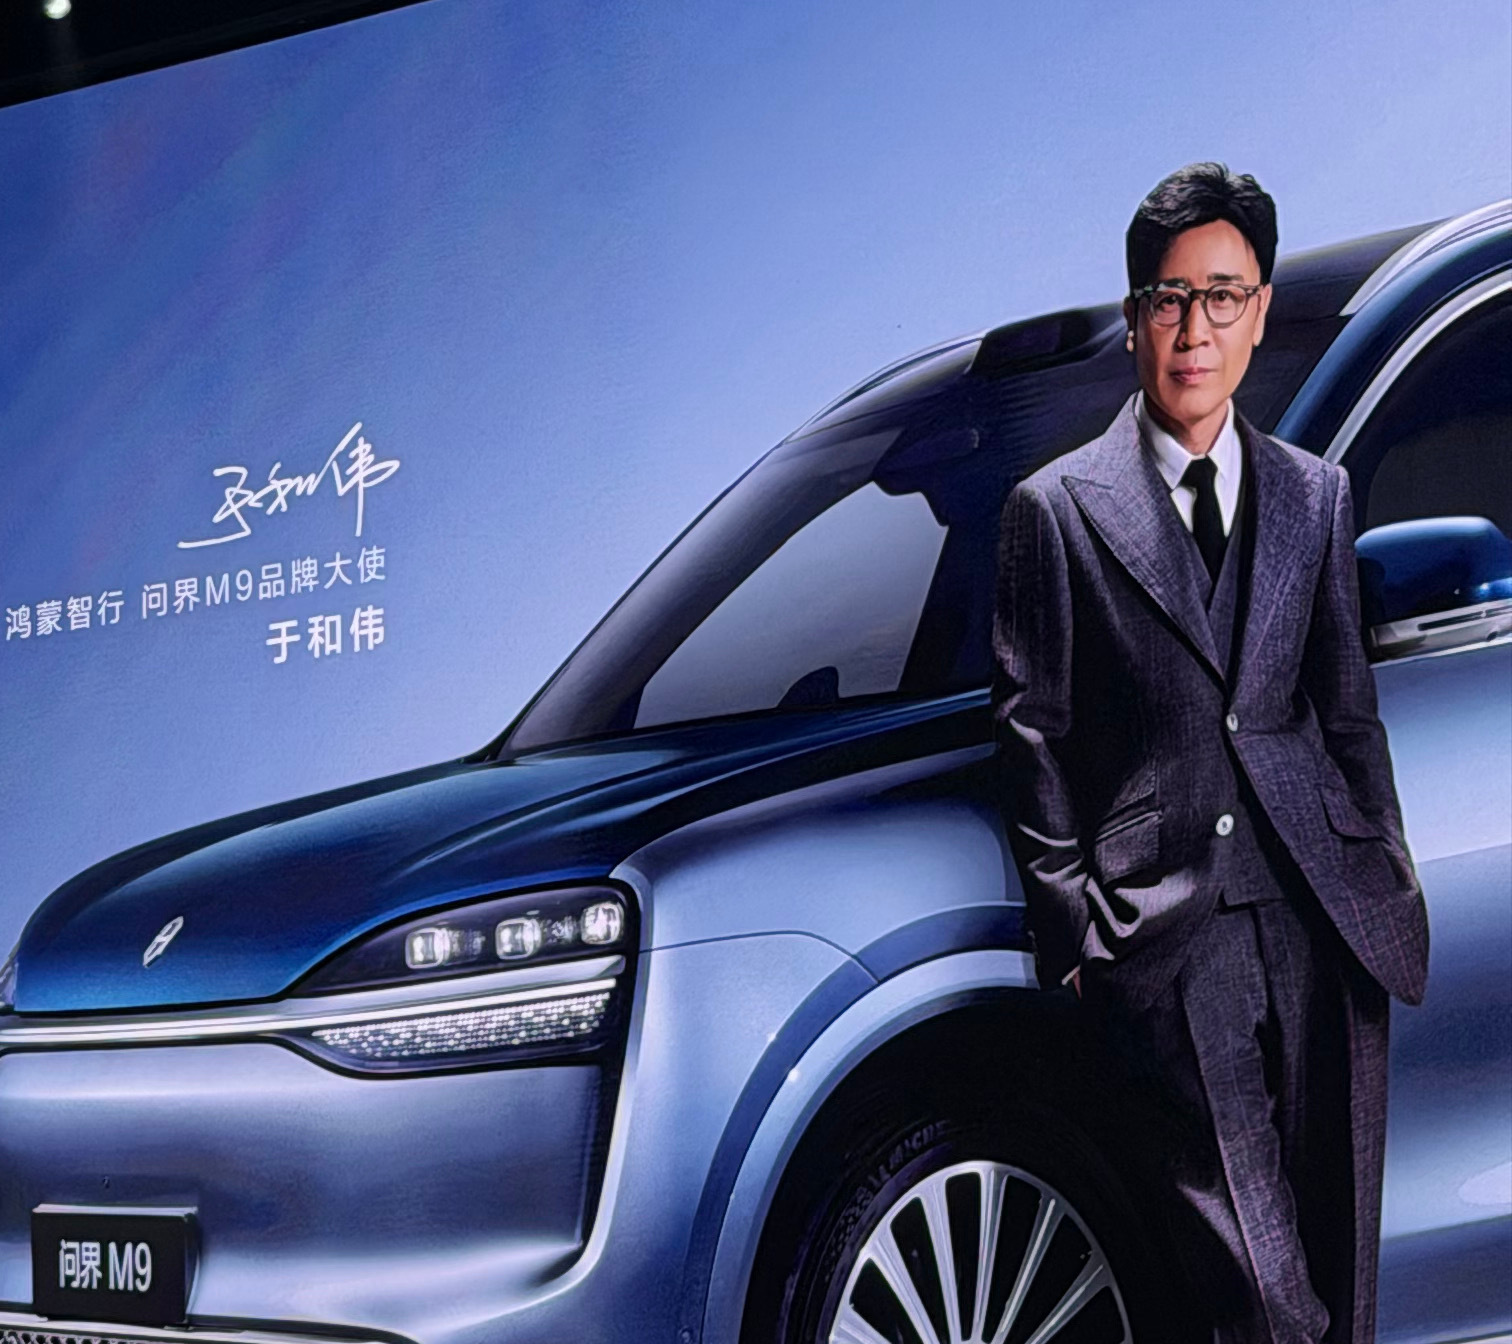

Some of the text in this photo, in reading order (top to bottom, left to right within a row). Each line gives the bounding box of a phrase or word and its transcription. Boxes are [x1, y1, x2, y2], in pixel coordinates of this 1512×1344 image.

[5, 545, 387, 641] 鸿蒙智行 问界M9品牌大使
[266, 605, 385, 665] 于和伟
[58, 1238, 152, 1293] 问界 M9
